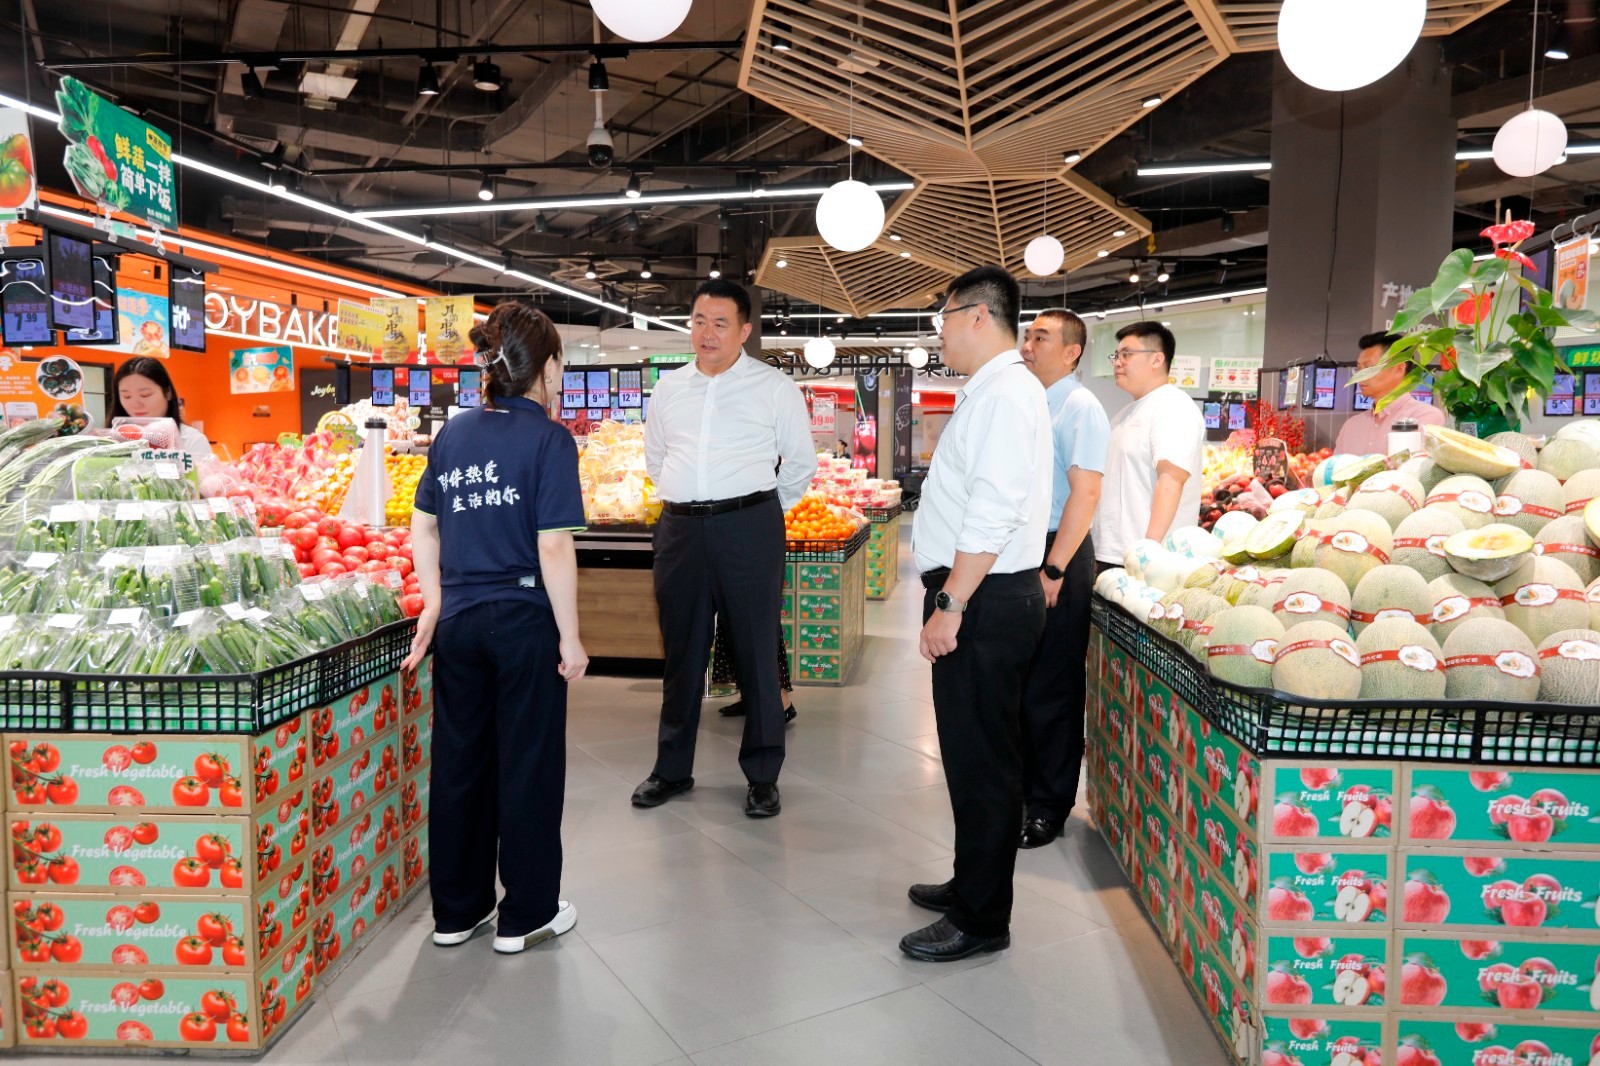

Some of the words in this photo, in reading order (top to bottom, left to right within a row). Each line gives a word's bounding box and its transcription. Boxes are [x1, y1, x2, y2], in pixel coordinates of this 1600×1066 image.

[115, 132, 172, 187] 鲜蔬一拌
[120, 162, 172, 212] 简单下饭
[452, 485, 521, 513] 生活的你
[70, 764, 108, 778] Fresh
[112, 765, 184, 781] Vegetable
[1300, 791, 1330, 802] Fresh
[1337, 791, 1369, 802] Fruits
[1486, 800, 1531, 815] Fresh
[1542, 802, 1589, 817] Fruits
[72, 844, 109, 858] Fresh
[114, 846, 184, 861] Vegetable
[1294, 875, 1325, 886] Fresh
[1331, 876, 1363, 886] Fruits
[1480, 884, 1524, 900] Fresh
[1536, 886, 1582, 902] Fruits
[74, 923, 111, 937] Fresh
[116, 924, 186, 940] Vegetable
[1294, 959, 1323, 969] Fresh
[1330, 959, 1362, 970] Fruits
[1477, 968, 1520, 982] Fresh
[1532, 970, 1578, 985] Fruits
[80, 1000, 116, 1014] Fresh
[120, 1001, 190, 1017] Vegetable
[1289, 1040, 1319, 1051] Fresh
[1326, 1041, 1358, 1053] Fruits
[1472, 1050, 1515, 1064] Fresh
[1526, 1052, 1573, 1066] Fruits
